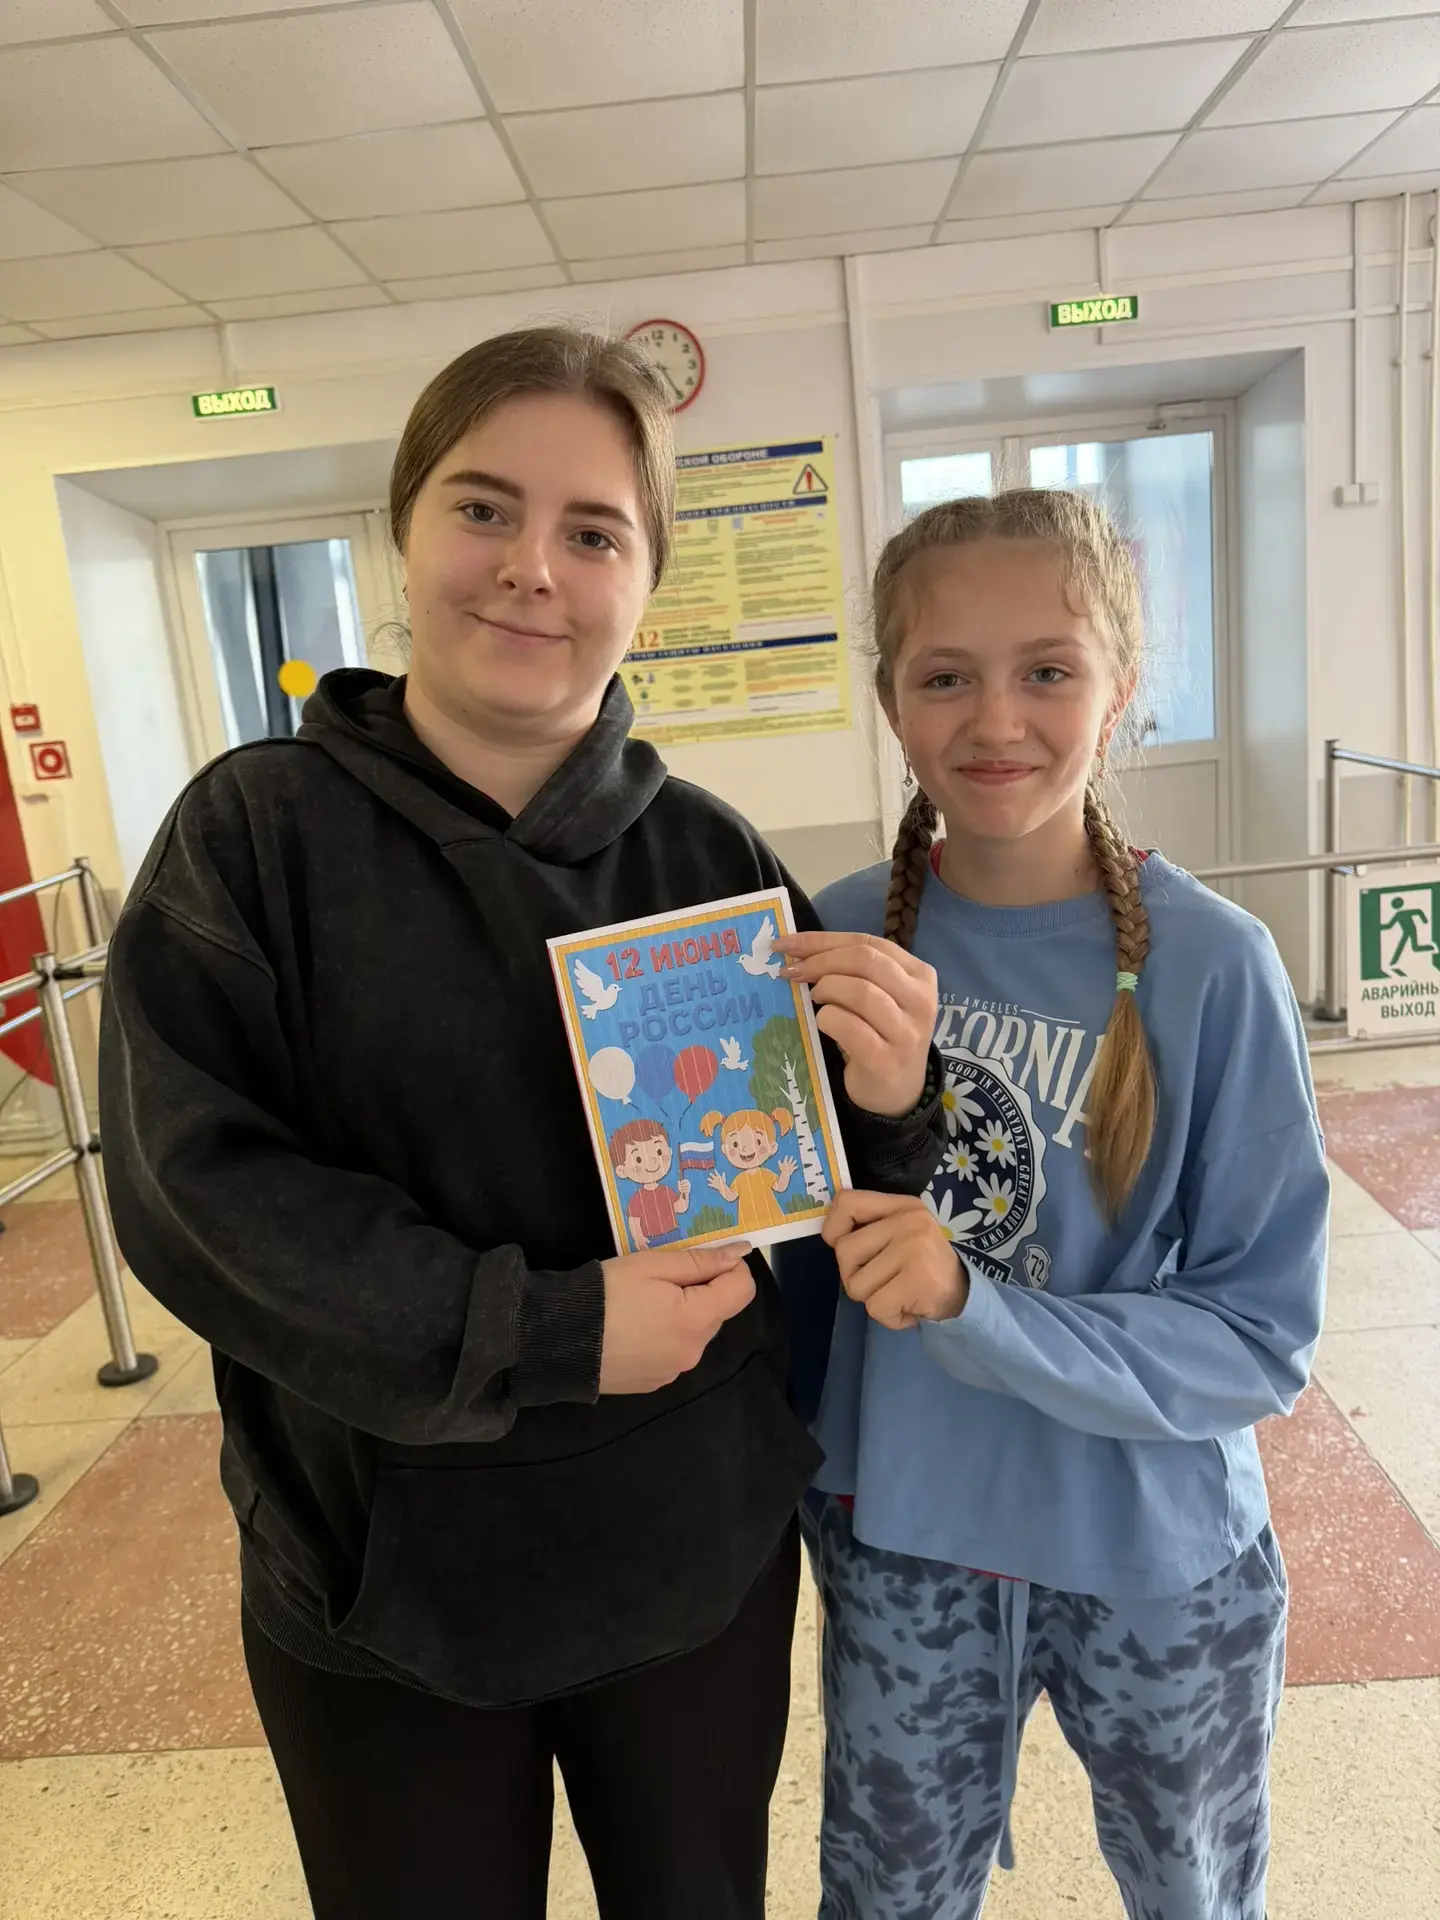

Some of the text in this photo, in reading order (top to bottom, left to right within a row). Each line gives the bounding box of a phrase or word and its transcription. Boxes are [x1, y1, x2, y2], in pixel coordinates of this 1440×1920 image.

[1058, 298, 1132, 324] ВЫХОД
[198, 389, 272, 414] ВЫХОД
[676, 455, 710, 468] СКОЙ
[632, 631, 660, 649] 12
[605, 927, 742, 981] 12 ИЮНЯ
[640, 970, 728, 1017] ДЕНЬ
[963, 996, 1019, 1016] ANGELES
[618, 992, 765, 1048] РОССИИ
[1381, 1000, 1435, 1019] ВЫХОД
[948, 1061, 1030, 1248] GOOD IN EVERYDAY GREAT YOUR OWN
[1031, 1254, 1045, 1282] 72
